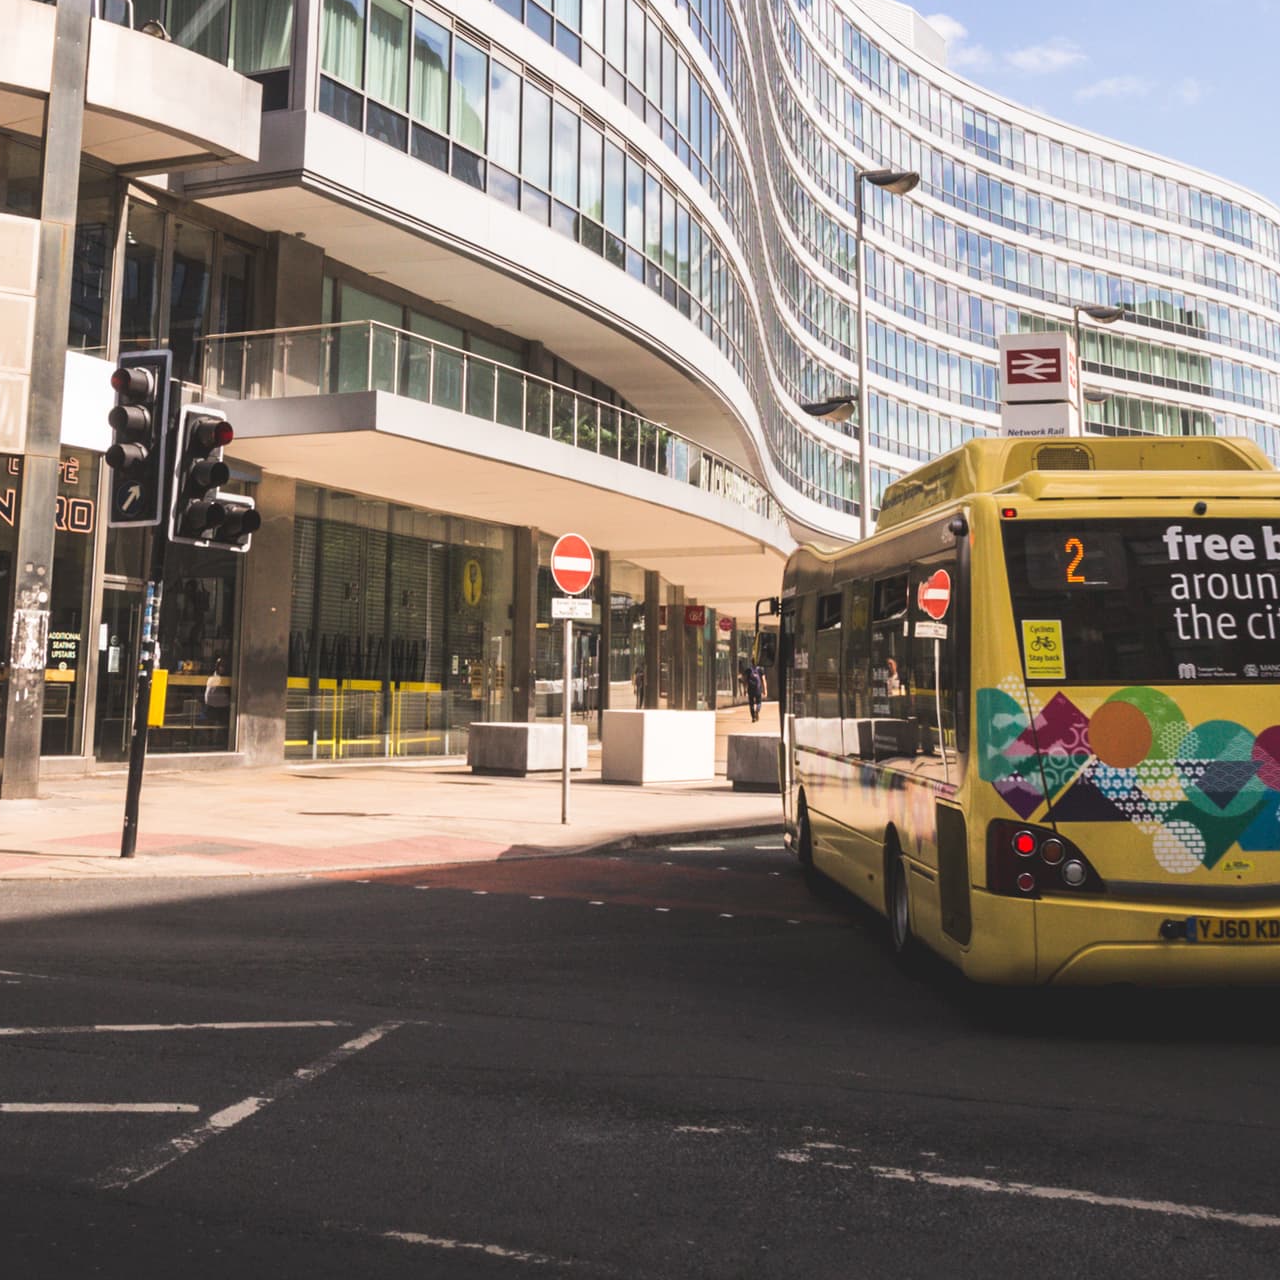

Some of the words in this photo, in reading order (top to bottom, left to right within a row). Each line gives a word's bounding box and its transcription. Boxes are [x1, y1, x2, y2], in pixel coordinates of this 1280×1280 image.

[1007, 427, 1046, 437] Network
[1048, 427, 1065, 435] Rail
[1064, 537, 1086, 583] 2
[1162, 525, 1256, 561] free
[1173, 603, 1237, 640] the
[1199, 919, 1250, 939] YJ60
